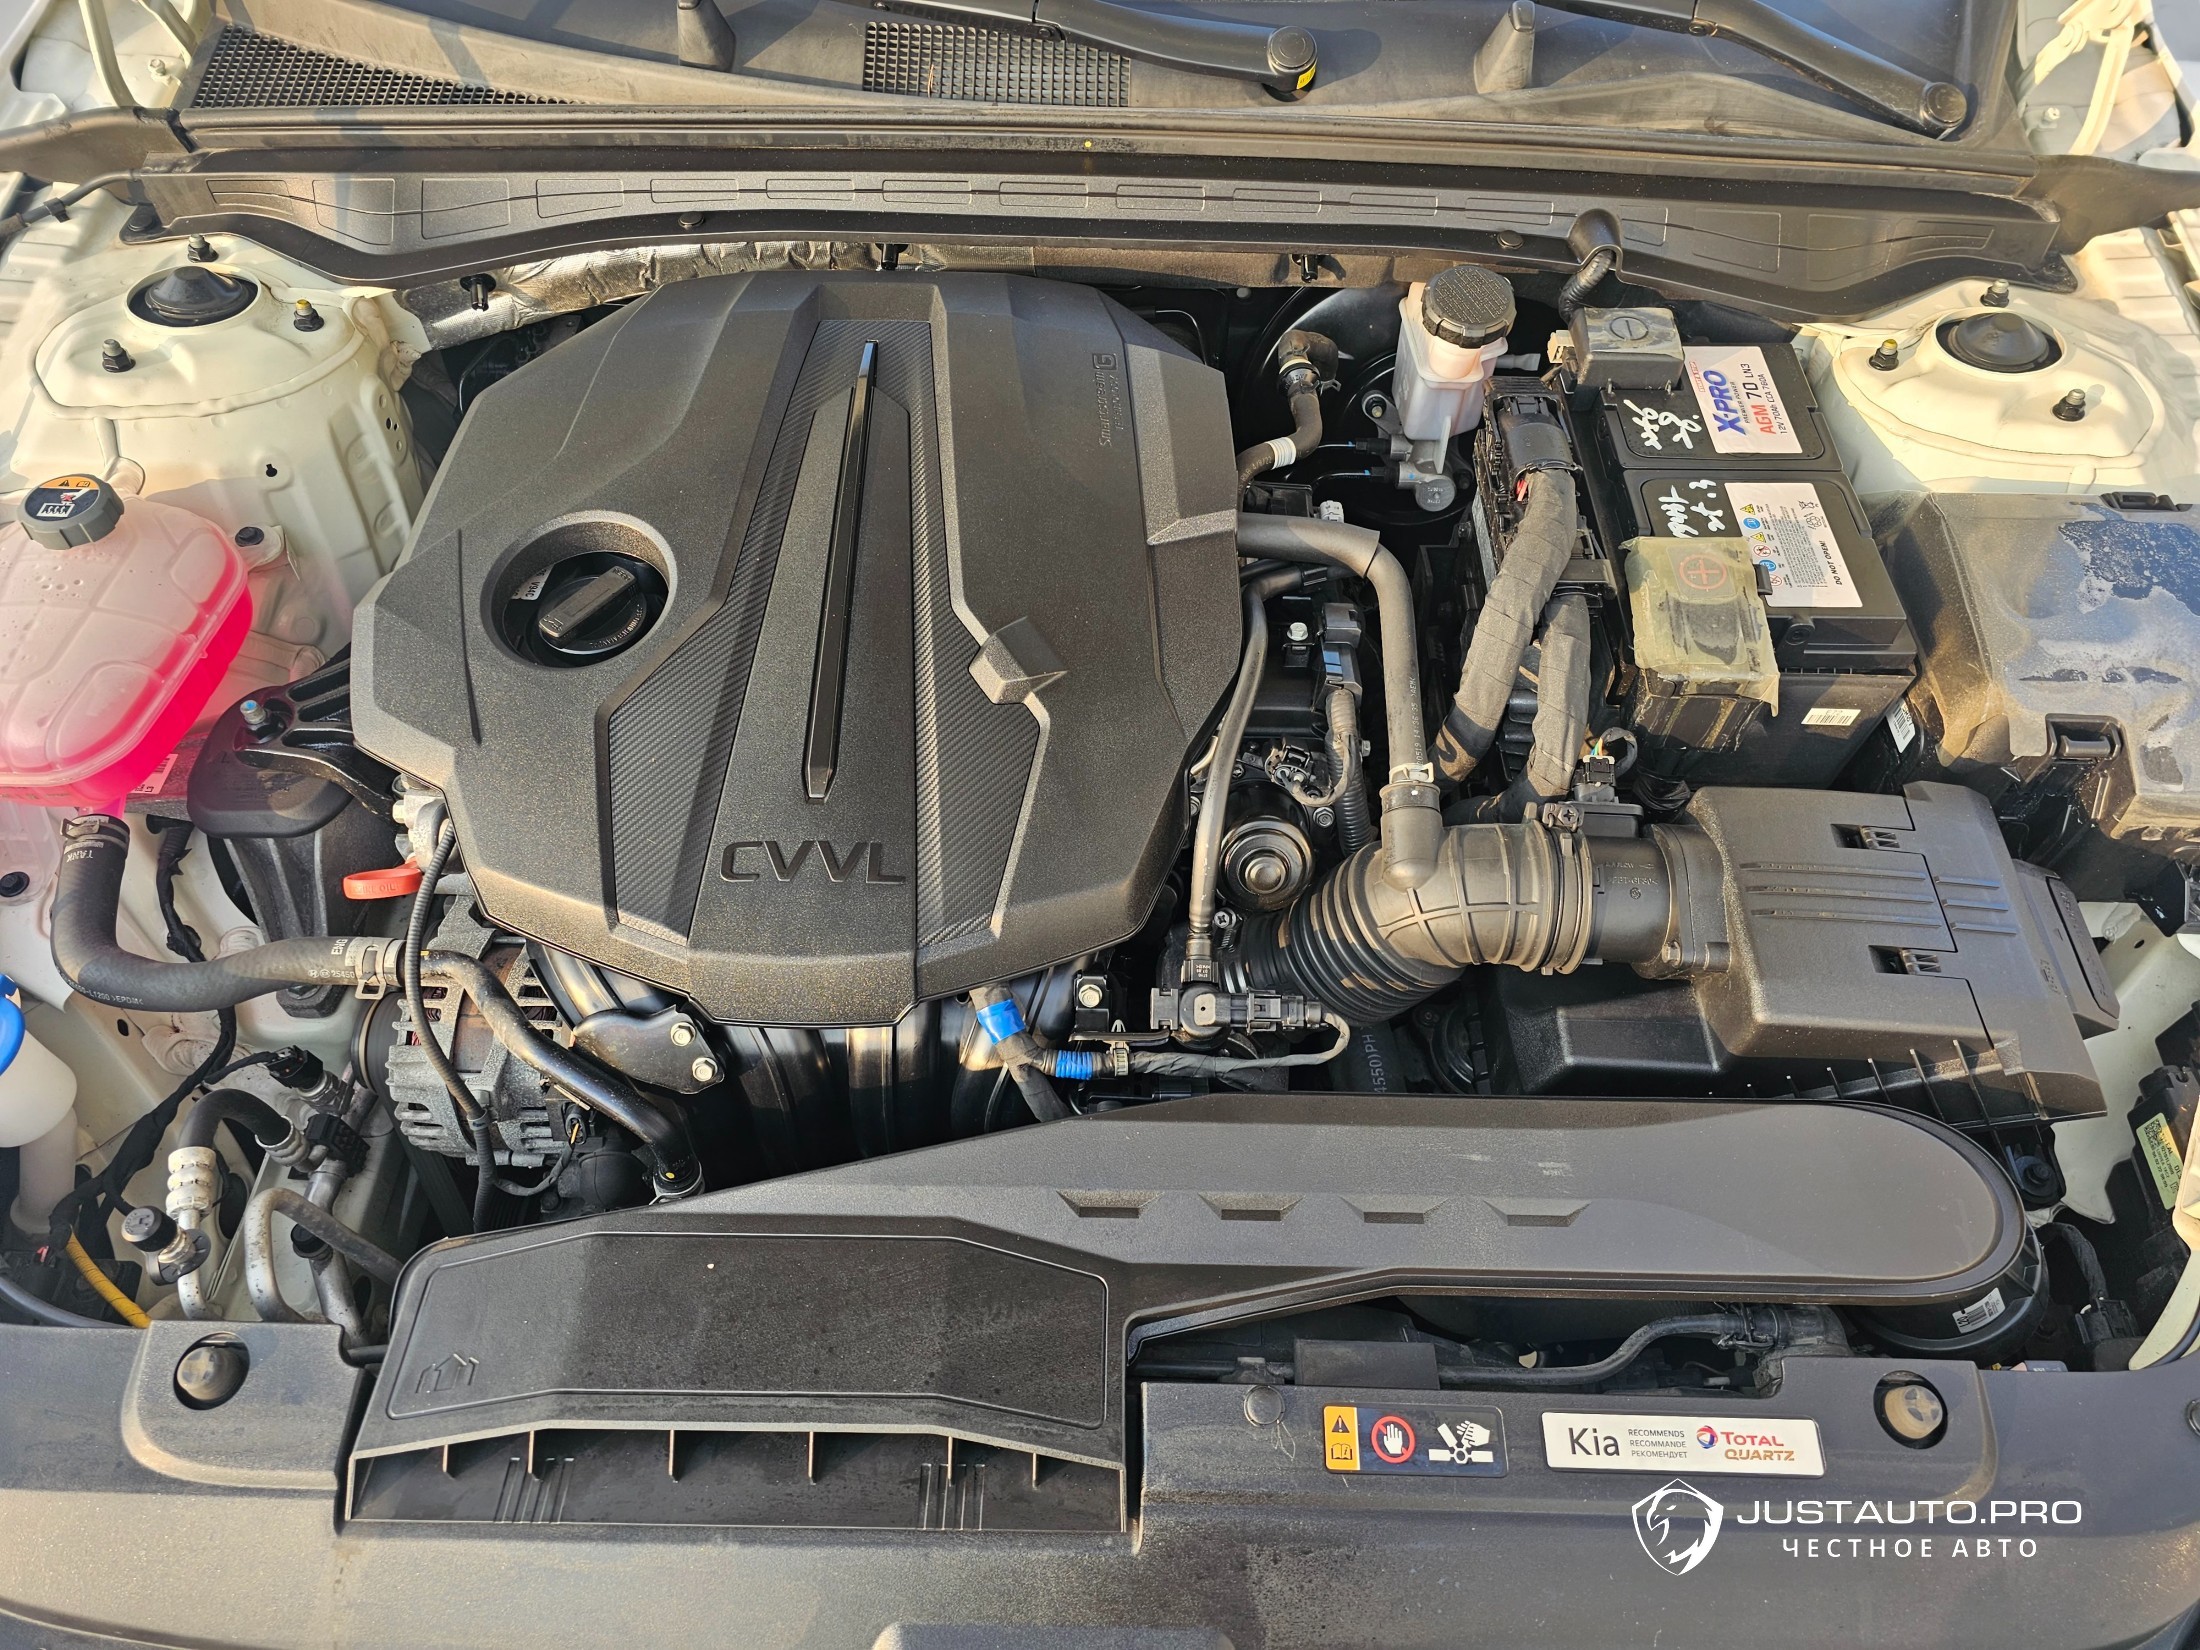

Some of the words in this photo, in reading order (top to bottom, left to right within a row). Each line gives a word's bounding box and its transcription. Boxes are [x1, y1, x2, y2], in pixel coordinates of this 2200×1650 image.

[1740, 363, 1754, 378] LN3
[1729, 381, 1742, 400] POWER
[1742, 382, 1763, 400] 70
[1765, 390, 1776, 403] CCA
[1095, 372, 1112, 447] Smartstream
[1703, 369, 1747, 435] X-PRO
[1737, 400, 1750, 424] PREMIER
[1751, 404, 1777, 435] AGM
[1776, 421, 1788, 434] 12V
[1819, 540, 1832, 560] OPEN!
[1827, 560, 1838, 575] NOT
[1833, 575, 1843, 586] DO
[66, 849, 94, 863] TANK
[720, 840, 907, 885] CVVL
[379, 882, 396, 892] OIL
[331, 939, 349, 955] ENG
[1627, 1428, 1685, 1438] RECOMMENDS
[1720, 1431, 1785, 1447] TOTAL
[1567, 1426, 1621, 1457] Kia
[1629, 1439, 1687, 1449] RECOMMANDE
[1631, 1449, 1688, 1459] РЕКОМЕНДУЕТ
[1724, 1448, 1795, 1462] QUARTZ
